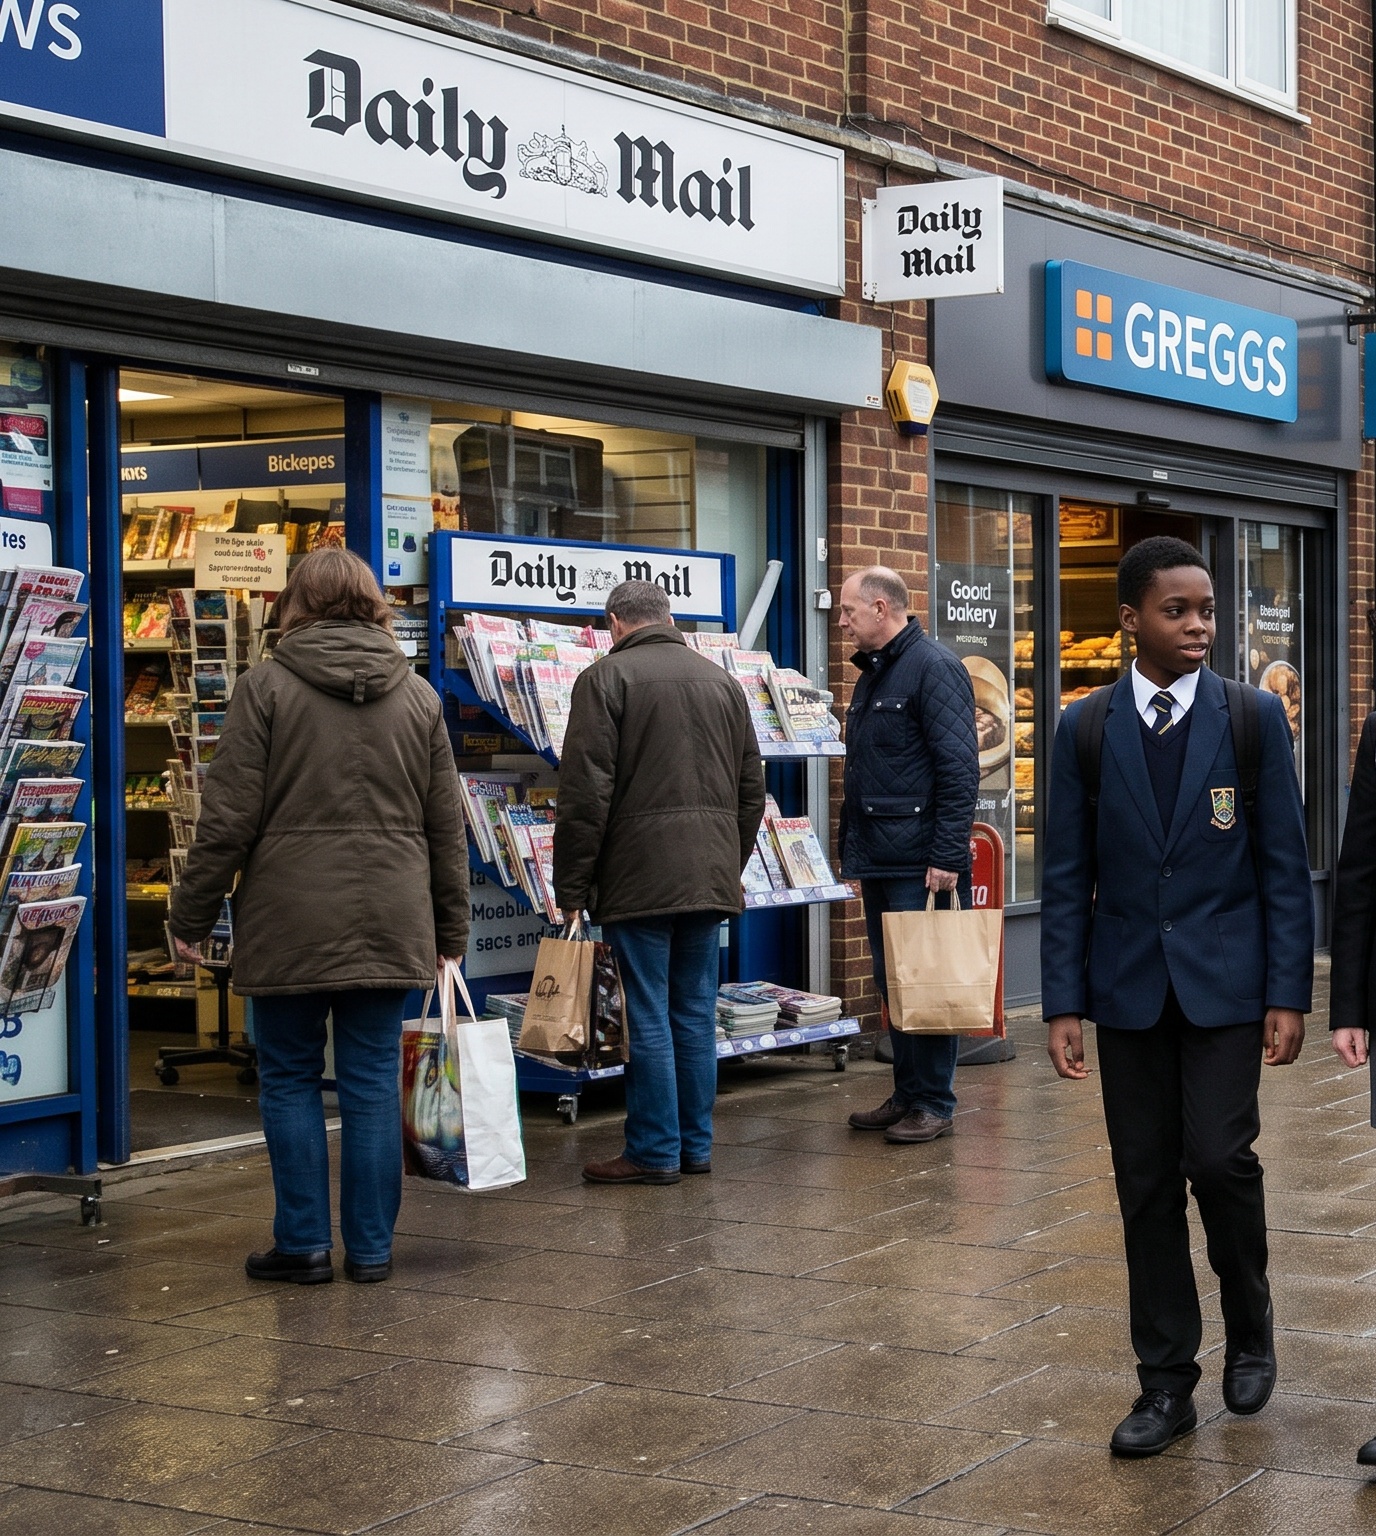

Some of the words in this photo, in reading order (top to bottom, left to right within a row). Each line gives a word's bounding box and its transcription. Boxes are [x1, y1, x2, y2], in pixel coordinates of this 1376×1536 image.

[303, 48, 509, 200] Daily
[613, 131, 756, 232] Mail
[896, 201, 983, 240] Daily
[900, 243, 976, 278] Mail
[1124, 301, 1288, 397] GREGGS
[268, 453, 335, 474] Bickepes
[488, 550, 577, 605] Daily
[947, 601, 997, 629] bakery
[476, 935, 512, 952] sacs
[517, 926, 544, 946] and
